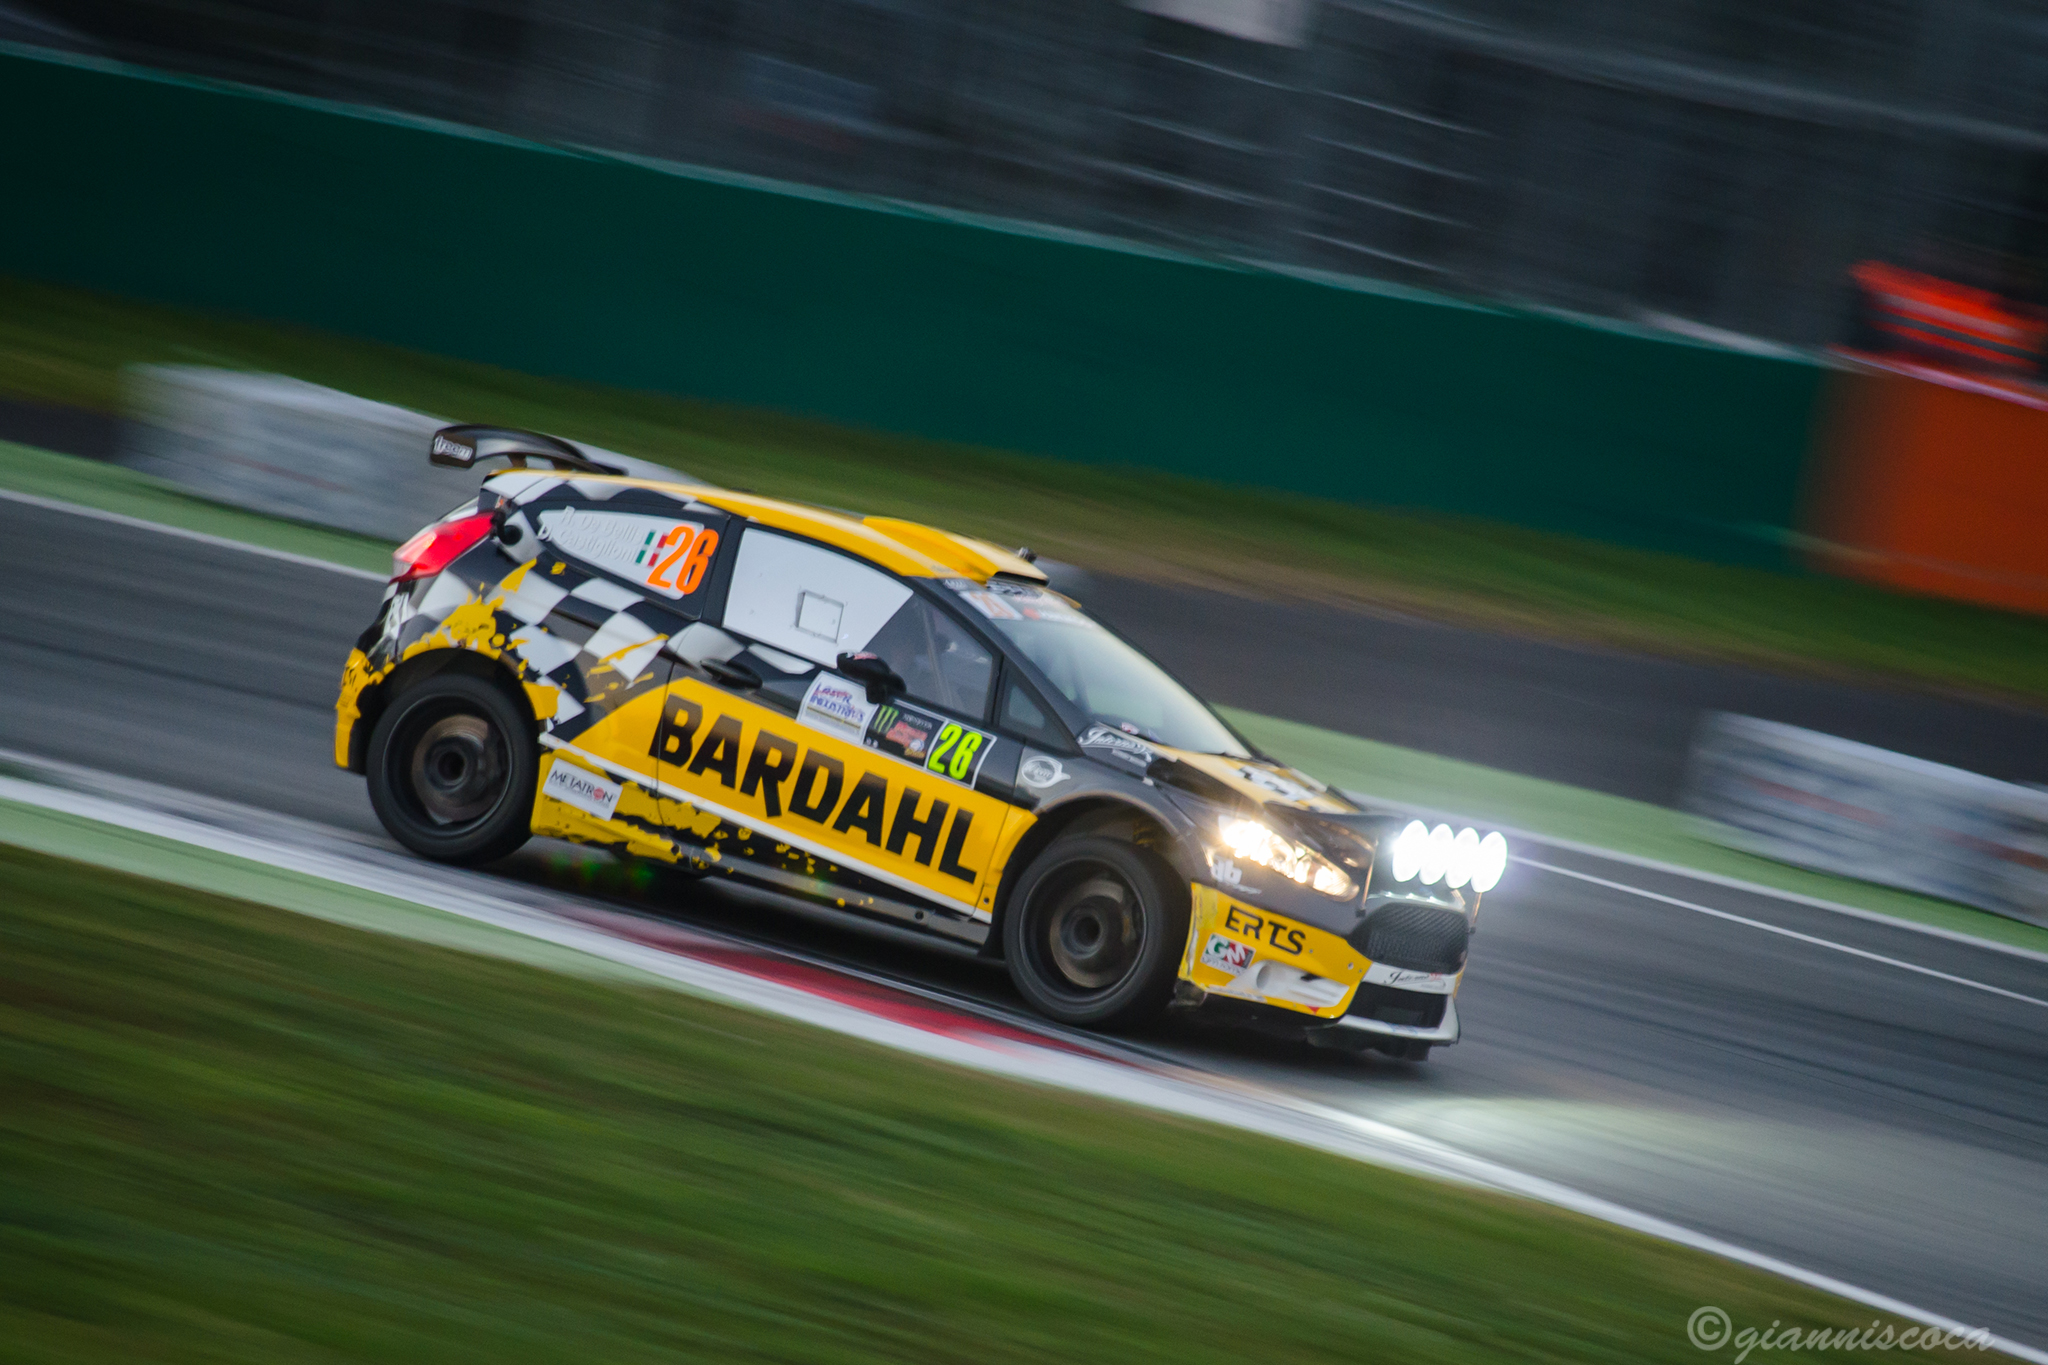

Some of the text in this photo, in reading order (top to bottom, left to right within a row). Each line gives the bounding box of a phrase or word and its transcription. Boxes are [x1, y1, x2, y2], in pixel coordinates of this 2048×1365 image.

[646, 524, 719, 594] 26
[927, 723, 982, 780] 26
[551, 769, 613, 802] METATRON
[648, 693, 977, 885] BARDAHL
[1225, 905, 1306, 956] ERTS
